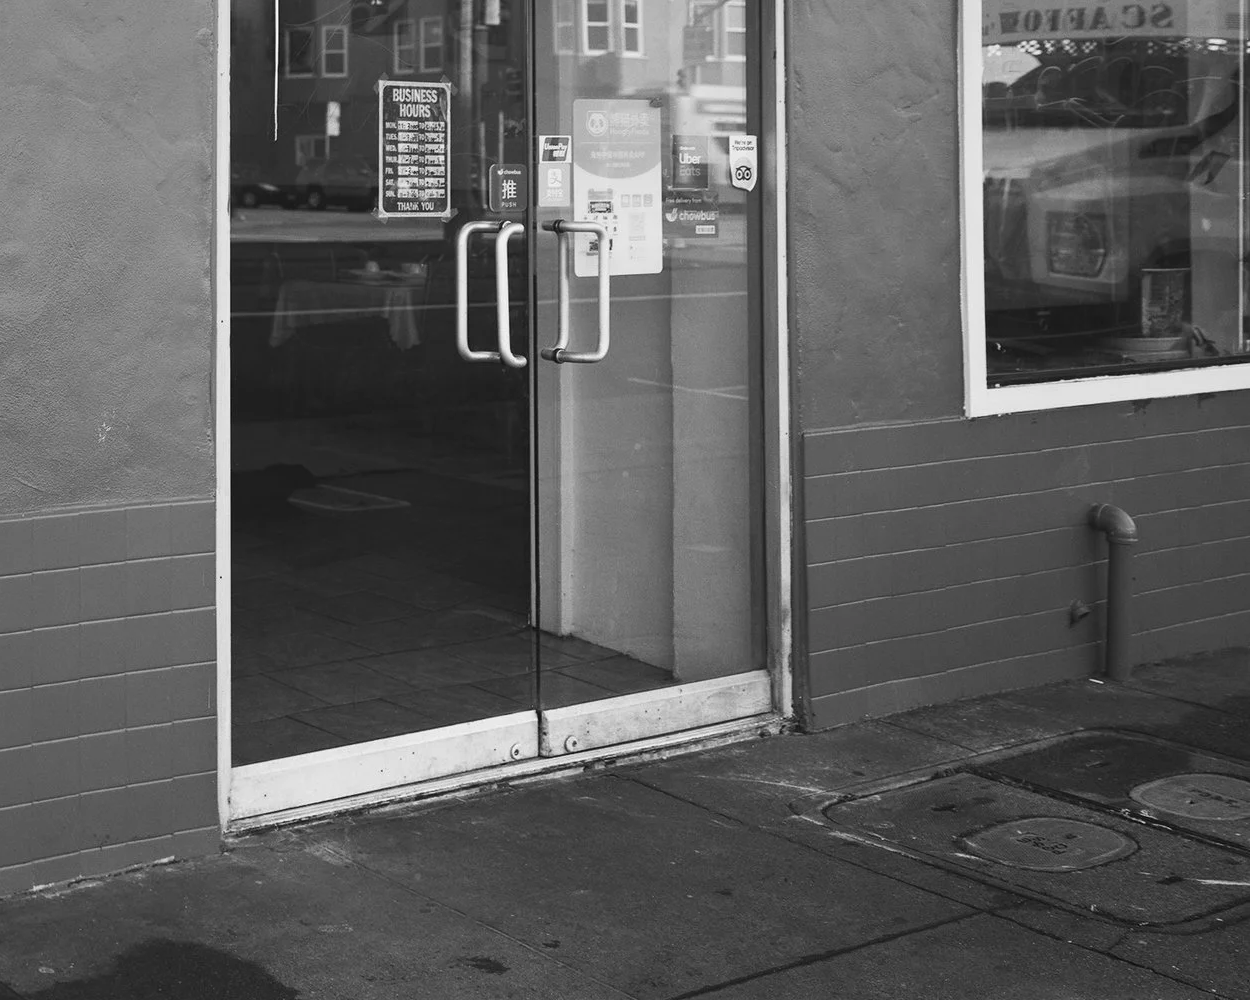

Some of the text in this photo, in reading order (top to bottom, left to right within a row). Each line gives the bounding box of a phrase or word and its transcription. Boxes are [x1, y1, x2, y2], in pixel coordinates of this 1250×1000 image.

[393, 88, 438, 103] BUSINESS
[400, 104, 431, 118] HOURS
[679, 152, 701, 164] Uber
[679, 165, 701, 176] Eats
[502, 180, 517, 199] 推
[397, 202, 434, 211] THANK YOU
[679, 210, 716, 220] chowbus
